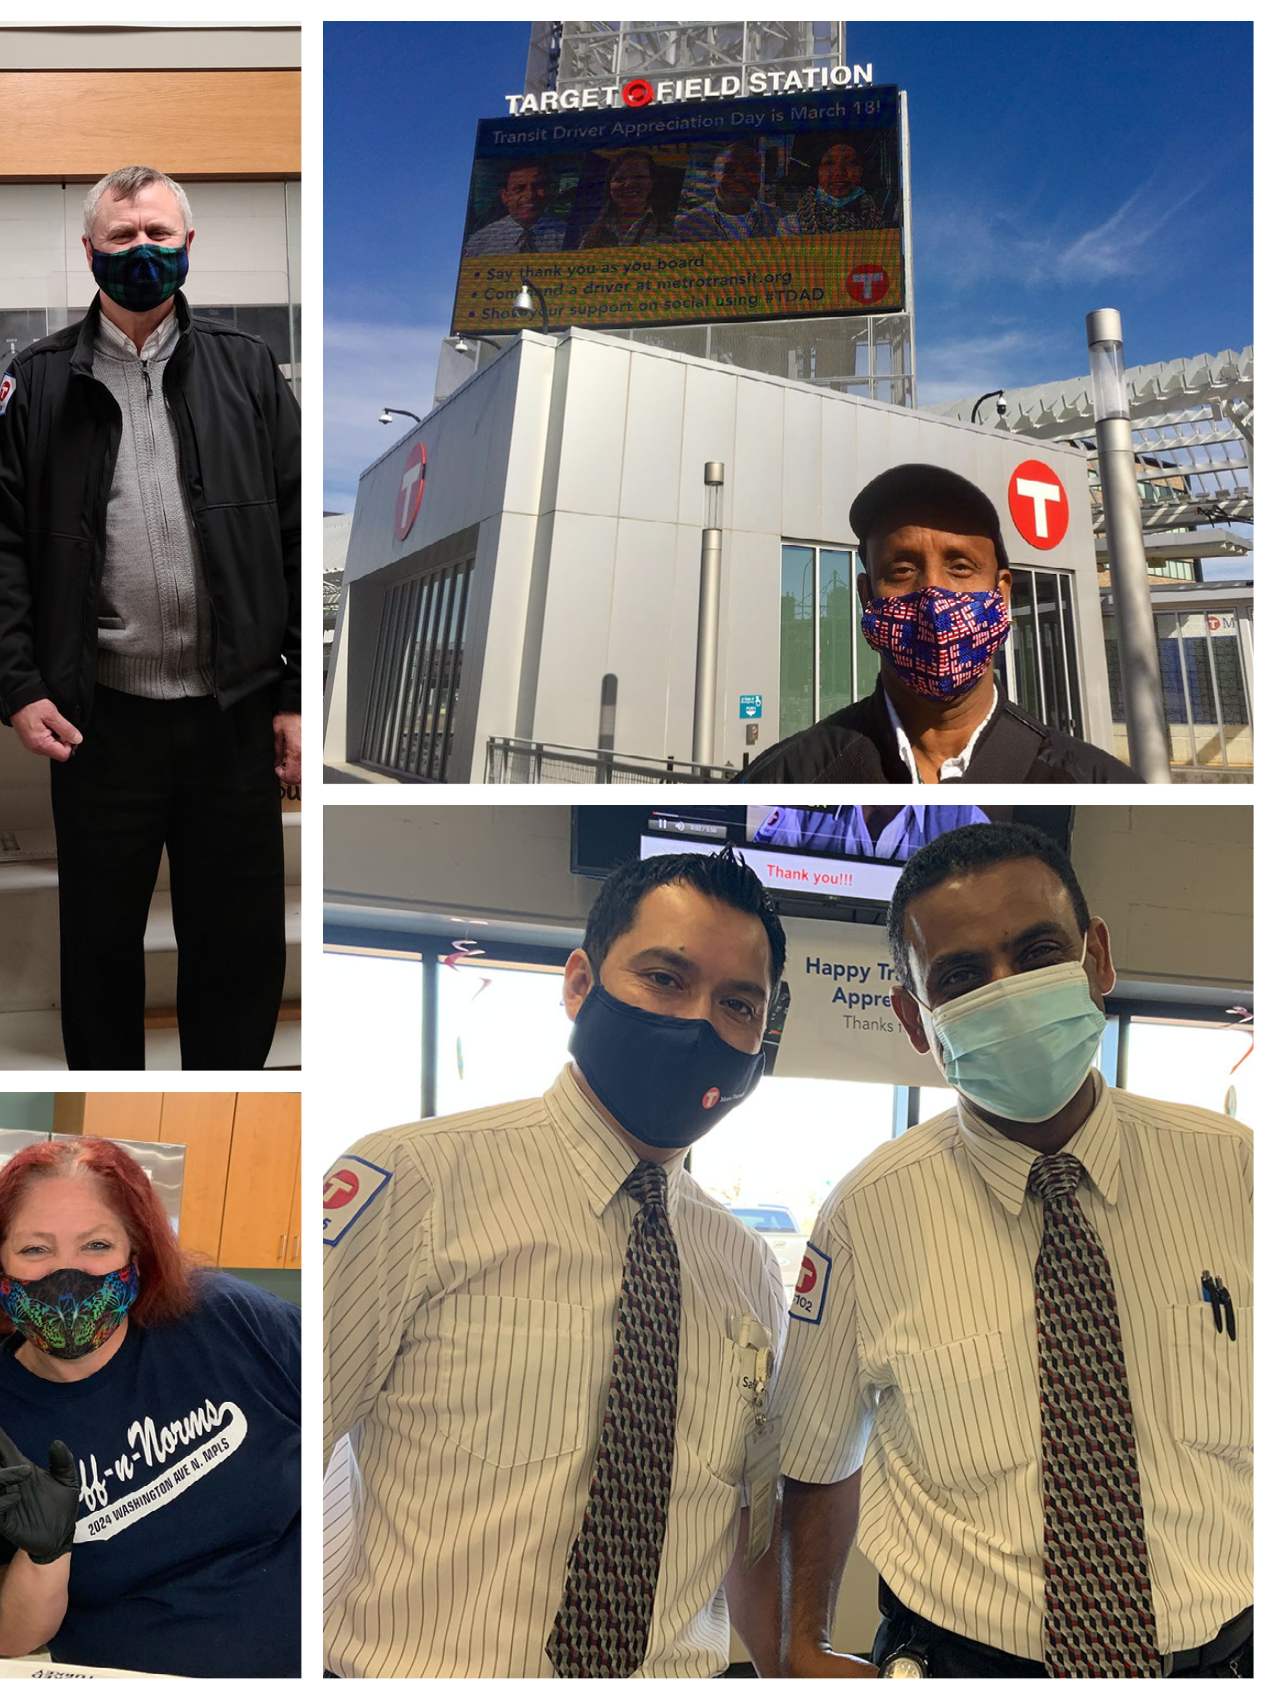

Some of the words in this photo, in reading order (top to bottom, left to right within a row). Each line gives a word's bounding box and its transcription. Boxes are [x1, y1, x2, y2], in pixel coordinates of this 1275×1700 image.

[505, 86, 619, 115] TARGET
[657, 75, 740, 101] FIELD
[749, 63, 873, 93] STATION
[492, 128, 547, 144] Transit
[553, 125, 606, 140] Driver
[611, 114, 724, 137] Appreciation
[731, 111, 765, 127] Day
[771, 108, 784, 122] is
[791, 102, 846, 120] March
[854, 100, 881, 115] 18!
[486, 268, 513, 282] Say
[519, 264, 563, 279] thank
[567, 265, 596, 277] you
[601, 263, 618, 274] as
[624, 261, 651, 275] you
[658, 254, 705, 271] board
[568, 287, 578, 296] a
[583, 281, 631, 295] driver
[636, 281, 651, 292] at
[657, 271, 792, 290] metrotransit.org
[852, 272, 883, 300] T
[570, 301, 633, 316] support
[638, 301, 658, 311] on
[664, 294, 709, 310] social
[716, 293, 759, 308] using
[765, 288, 825, 303] #TDAD
[401, 461, 422, 529] T
[1016, 477, 1061, 538] T
[767, 864, 809, 882] Thank
[813, 872, 853, 887] you!!!
[806, 956, 871, 984] Happy
[843, 1014, 894, 1033] Thanks
[707, 1091, 718, 1108] T
[79, 1399, 221, 1511] ff-n-Norms
[88, 1515, 112, 1536] 2024
[113, 1477, 174, 1521] WASHINGTON
[175, 1464, 190, 1485] AVE
[191, 1460, 204, 1472] N.
[203, 1438, 230, 1462] MPLS
